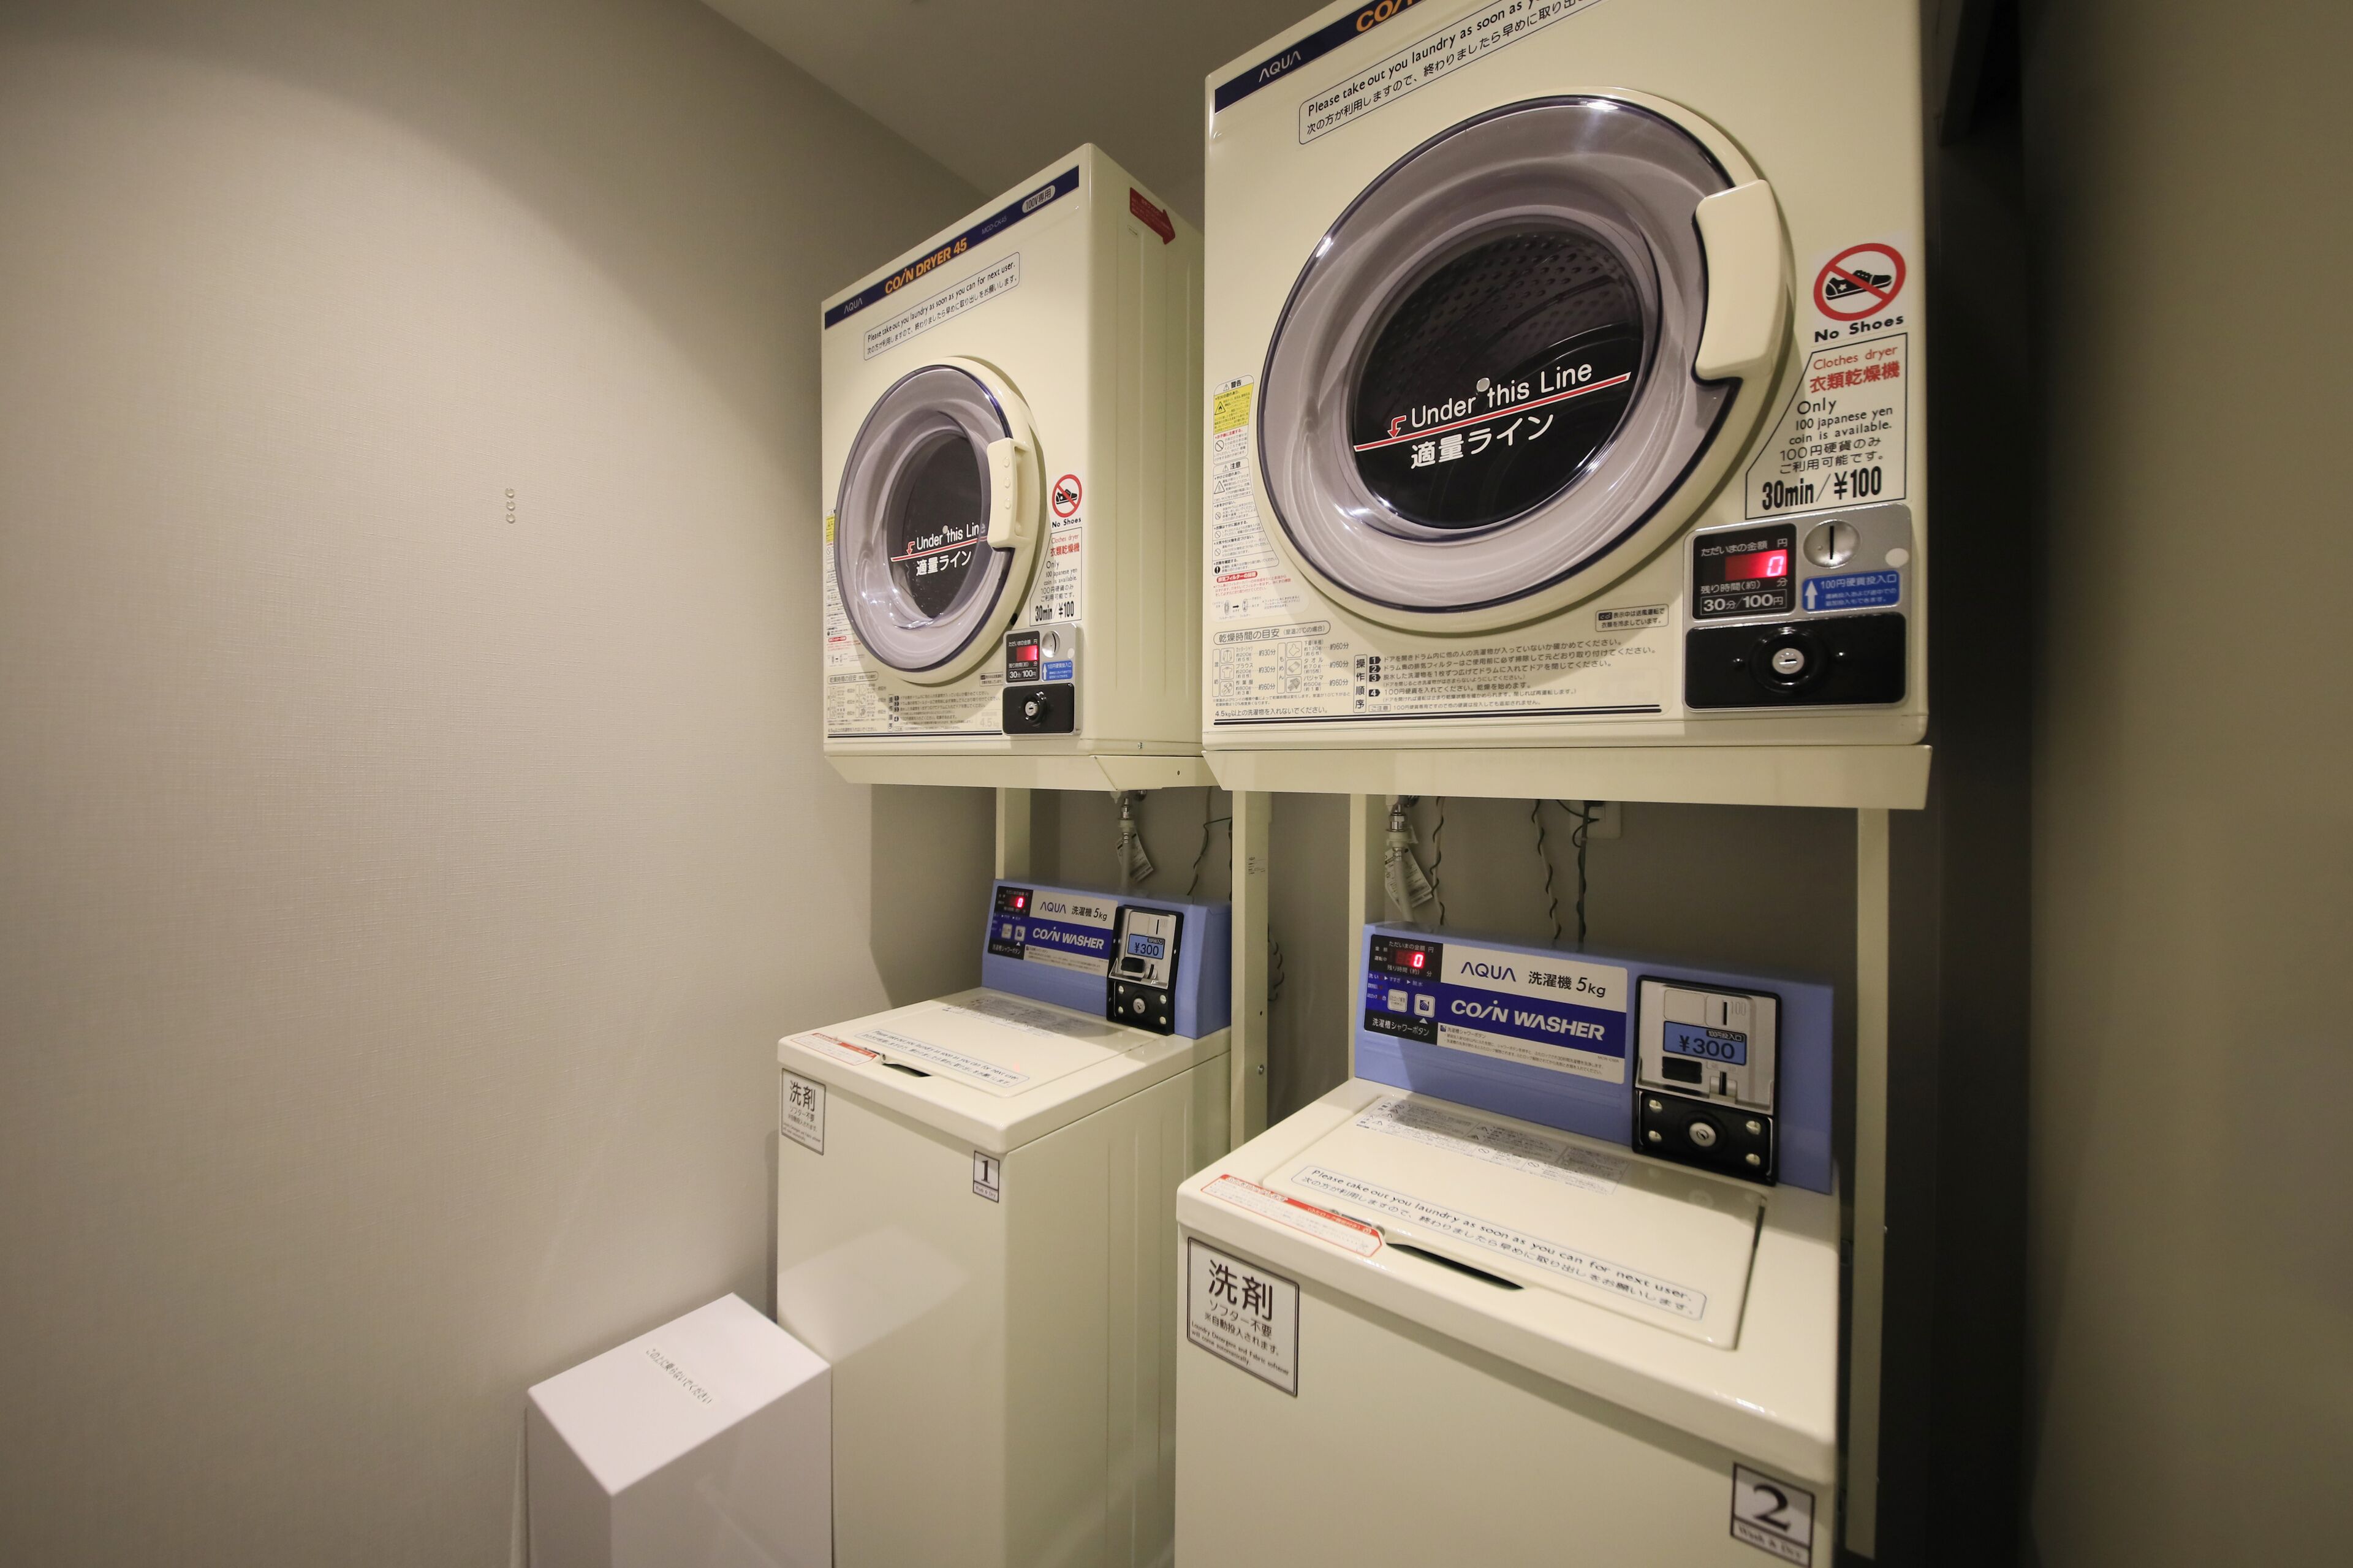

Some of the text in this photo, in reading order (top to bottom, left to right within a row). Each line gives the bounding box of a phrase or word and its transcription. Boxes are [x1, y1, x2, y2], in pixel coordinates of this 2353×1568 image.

[1259, 50, 1302, 83] AQUA
[1308, 93, 1340, 116] Please
[1343, 82, 1366, 99] take
[1368, 70, 1385, 86] out
[1389, 59, 1408, 80] you
[1412, 34, 1456, 64] laundry
[1460, 26, 1472, 39] as
[1477, 10, 1505, 31] soon
[1509, 3, 1523, 15] as
[1025, 188, 1052, 211] 100V専用
[885, 237, 968, 295] COIN DRYER 45
[844, 297, 863, 314] AQUA
[868, 330, 882, 343] Please
[882, 325, 892, 335] take
[892, 320, 901, 330] out
[901, 314, 910, 328] you
[910, 306, 929, 320] laundry
[936, 297, 948, 308] soon
[949, 292, 955, 301] as
[955, 287, 966, 300] you
[966, 282, 976, 292] can
[987, 269, 1001, 281] next
[1001, 262, 1016, 274] user.
[1814, 315, 1904, 343] No Shoes
[1813, 346, 1898, 370] Clothes dryer
[1809, 360, 1900, 394] 衣類乾燥機
[1411, 363, 1593, 428] Under this Line
[1797, 397, 1837, 415] Only
[1795, 406, 1893, 431] 100 japanese yen
[1411, 414, 1555, 469] 適量ライン
[1789, 420, 1893, 445] coin is available.
[1779, 436, 1882, 463] 100円硬貨のみ
[1230, 461, 1241, 470] 注意
[1779, 450, 1885, 475] ご利用可能です。
[916, 534, 943, 550] Under
[946, 528, 964, 543] this
[1701, 538, 1788, 557] ただいまの金額 円
[916, 550, 972, 577] 適量ライン
[1046, 561, 1059, 569] Only
[1767, 555, 1784, 577] 0
[1777, 577, 1788, 588] 分
[1219, 629, 1280, 643] 乾燥時間の目安
[1017, 897, 1023, 908] 0
[1040, 902, 1107, 921] AQUA 洗濯機 5kg
[1033, 926, 1104, 950] COIN WASHER
[1134, 942, 1159, 956] ¥300
[1413, 953, 1423, 968] 0
[1461, 961, 1606, 998] AQUA 洗濯機 5kg
[1373, 1018, 1430, 1036] 洗濯槽シャワーボタン
[1450, 1000, 1605, 1041] COIN WASHER
[1679, 1035, 1735, 1059] ¥300
[789, 1080, 816, 1112] 洗剤
[980, 1160, 990, 1184] 1
[1311, 1168, 1692, 1302] Please take out you laundry as soon as you can for next user.
[1209, 1259, 1273, 1321] 洗剤
[1210, 1300, 1272, 1339] ソフター不要
[1191, 1330, 1200, 1339] will
[1238, 1346, 1248, 1356] and
[1753, 1483, 1792, 1532] 2
